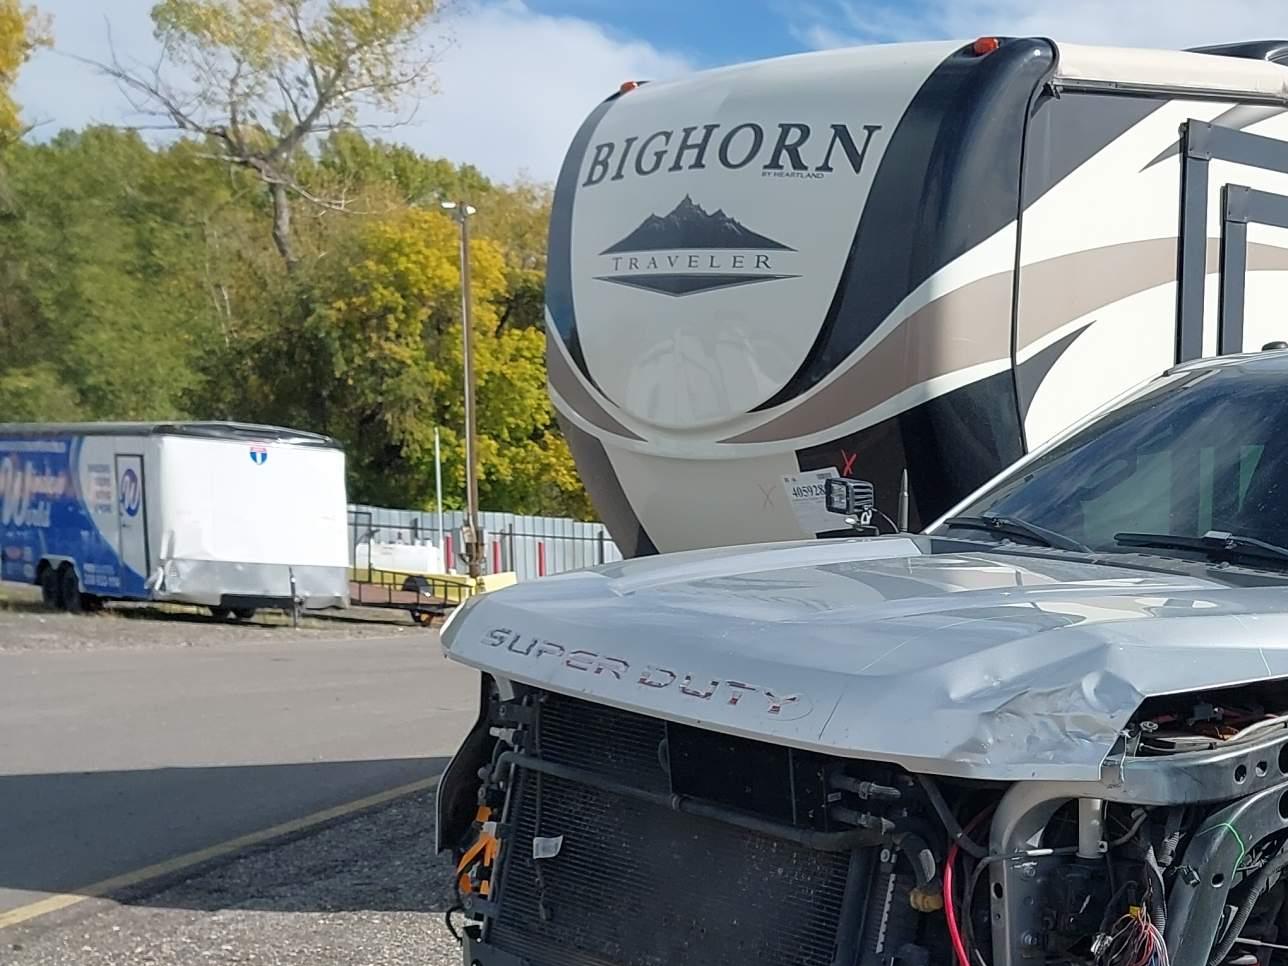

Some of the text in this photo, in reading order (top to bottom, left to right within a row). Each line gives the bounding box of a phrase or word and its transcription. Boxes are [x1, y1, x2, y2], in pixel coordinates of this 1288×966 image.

[581, 122, 884, 188] BIGHORN
[774, 171, 825, 179] HEARTLAND
[611, 253, 773, 271] TRAVELER
[480, 627, 802, 716] SUPER DUTY
